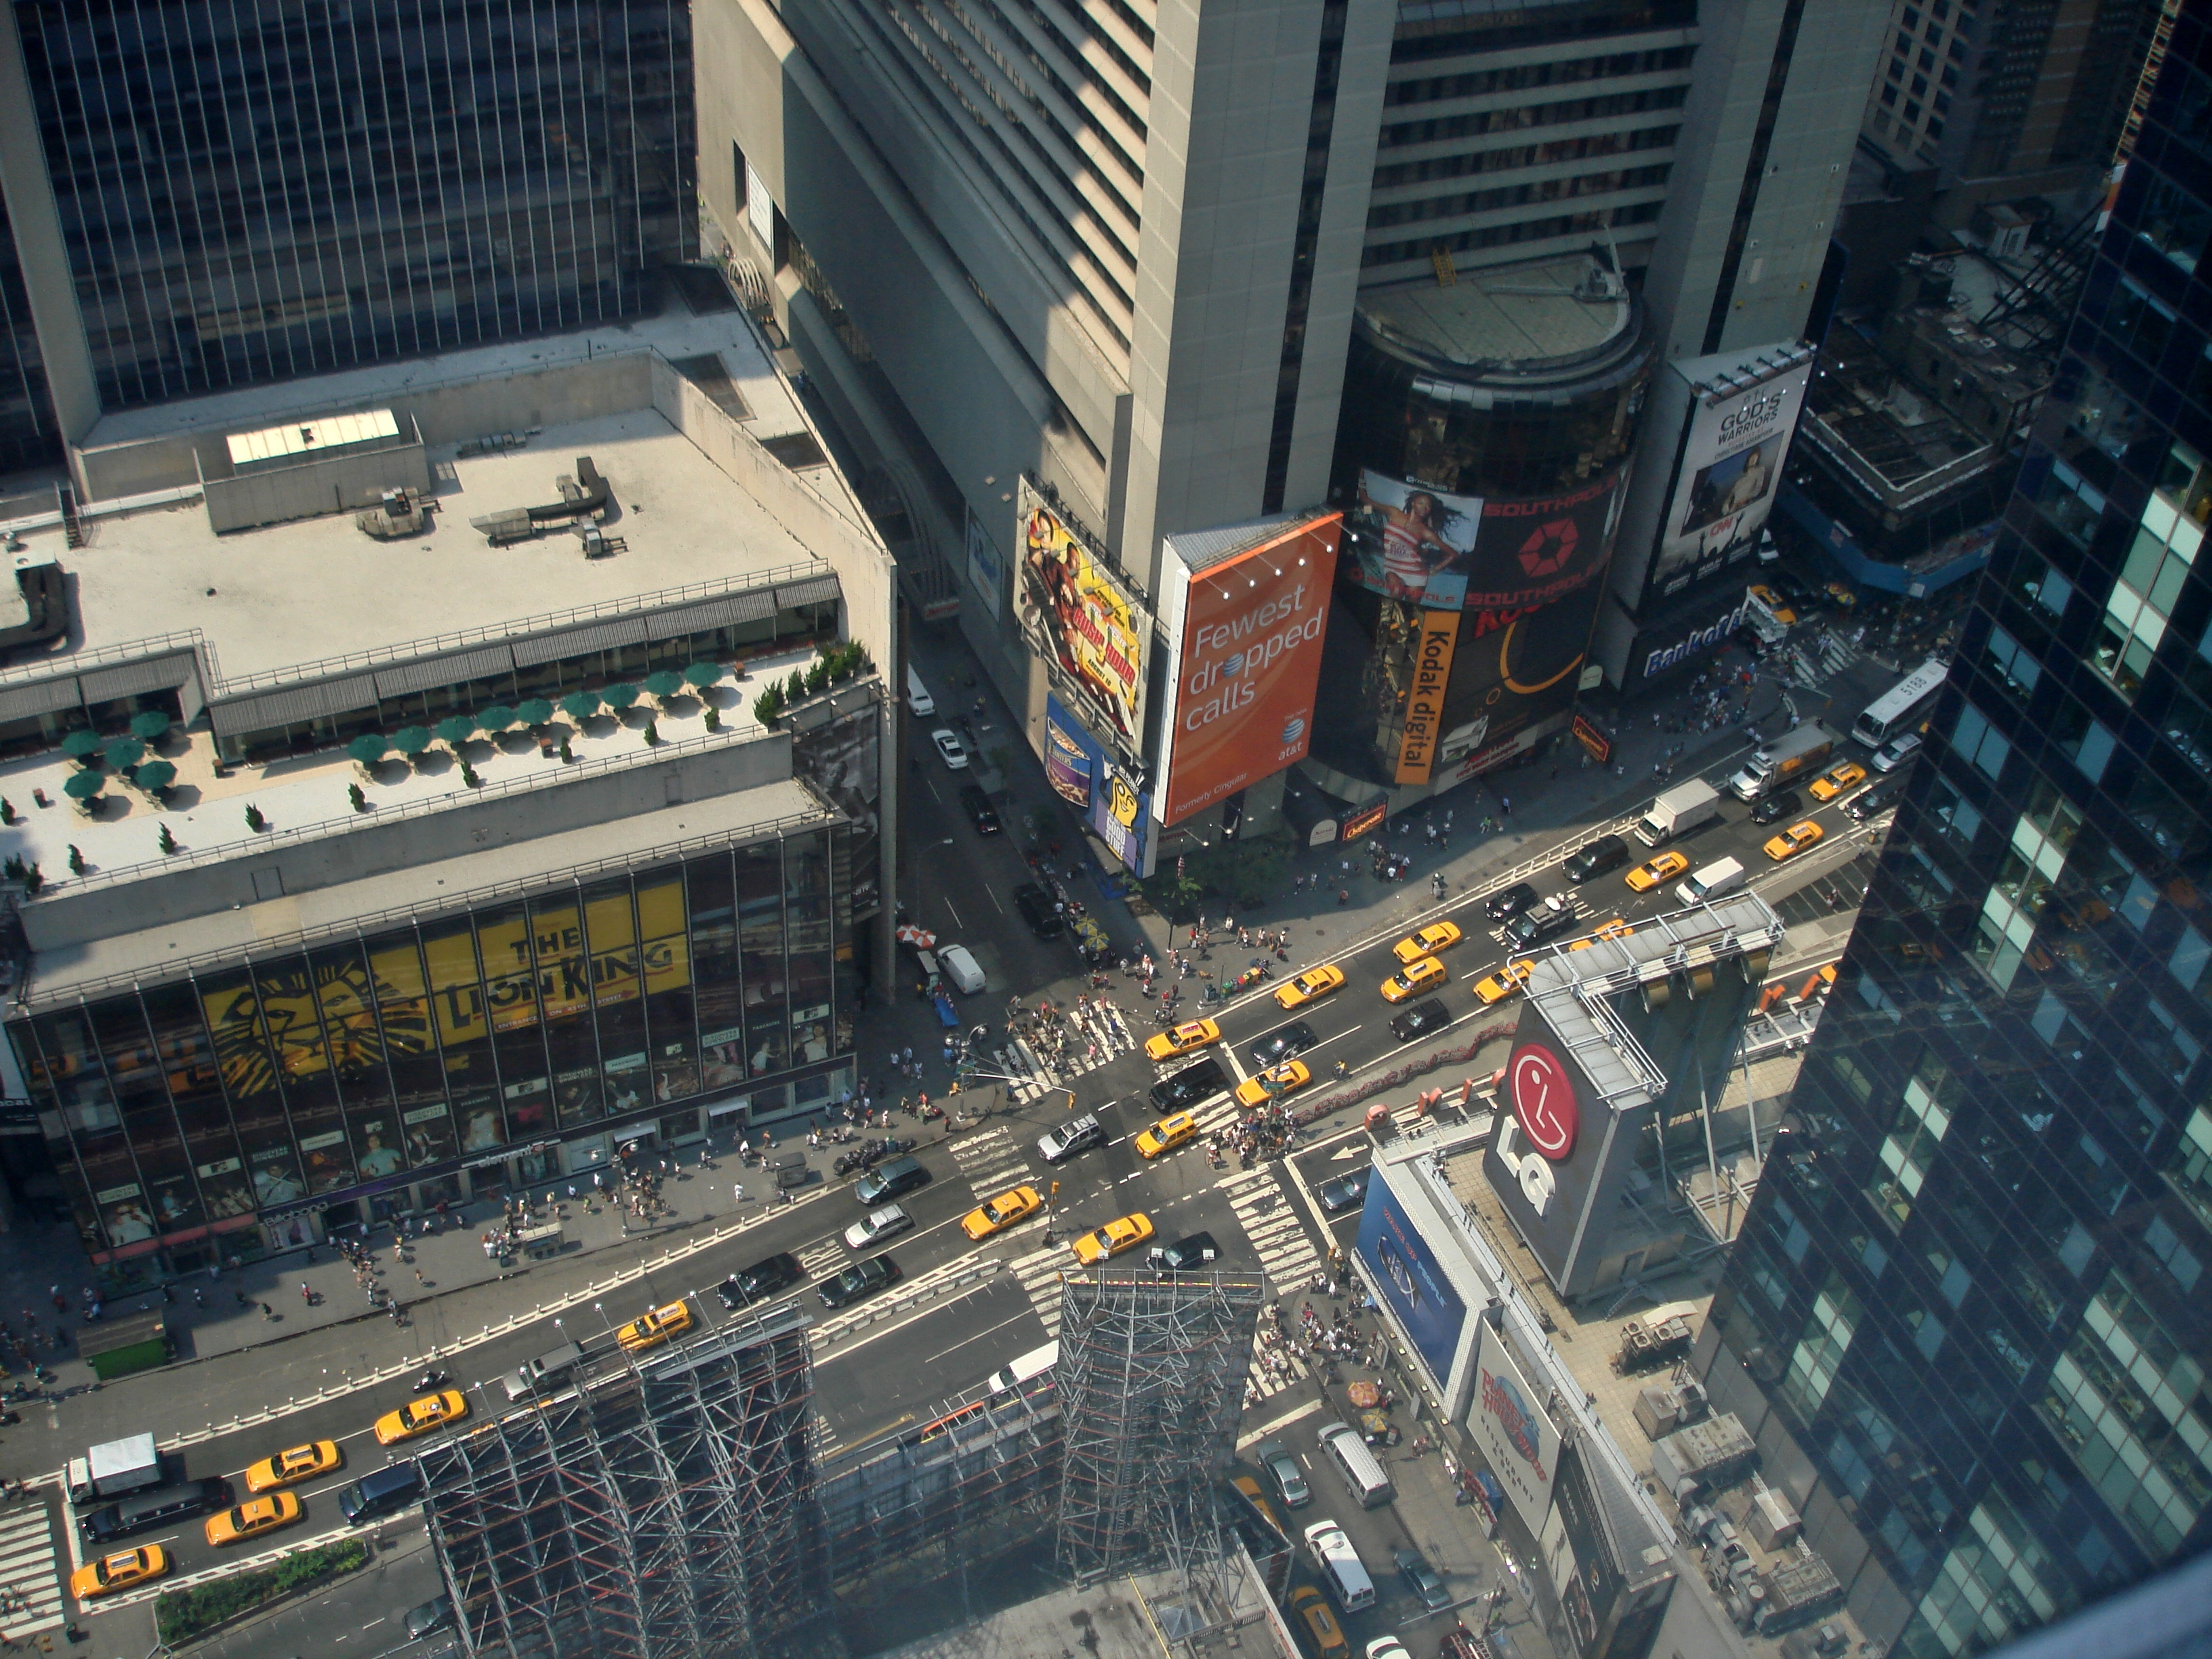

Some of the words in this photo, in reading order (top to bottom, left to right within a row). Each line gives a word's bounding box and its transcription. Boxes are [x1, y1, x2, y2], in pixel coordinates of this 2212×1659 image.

[1718, 408, 1778, 446] WARRIORS
[1721, 393, 1782, 432] GOD'S
[1483, 474, 1617, 518] SOUTHPOLE
[1710, 516, 1734, 537] CNN
[1465, 562, 1594, 606] SOUTHPOLE
[1195, 583, 1305, 659] Fewest
[1073, 607, 1105, 645] RUSH
[1105, 642, 1136, 689] HOUR
[1087, 658, 1106, 680] AUGUST
[1416, 630, 1450, 696] Kodak
[1643, 630, 1704, 678] Bank
[1186, 681, 1255, 731] calls
[1278, 741, 1303, 761] at&t
[1404, 703, 1437, 768] digital
[1175, 789, 1212, 814] Formerly
[1214, 771, 1248, 795] Cingular
[1105, 829, 1125, 857] STUFF
[1107, 815, 1126, 846] GOOD
[510, 926, 581, 963] THE
[446, 972, 555, 1029] LION
[560, 943, 674, 1001] KING
[497, 1015, 538, 1030] ENTRANCE
[549, 1008, 563, 1017] ON
[596, 994, 623, 1005] STREET
[1496, 1115, 1556, 1217] LG
[1417, 1260, 1447, 1308] PEOPLE
[1481, 1367, 1528, 1427] PLANET
[1480, 1414, 1534, 1503] RESTAURANT
[1481, 1389, 1547, 1482] HOLLYWOOD
